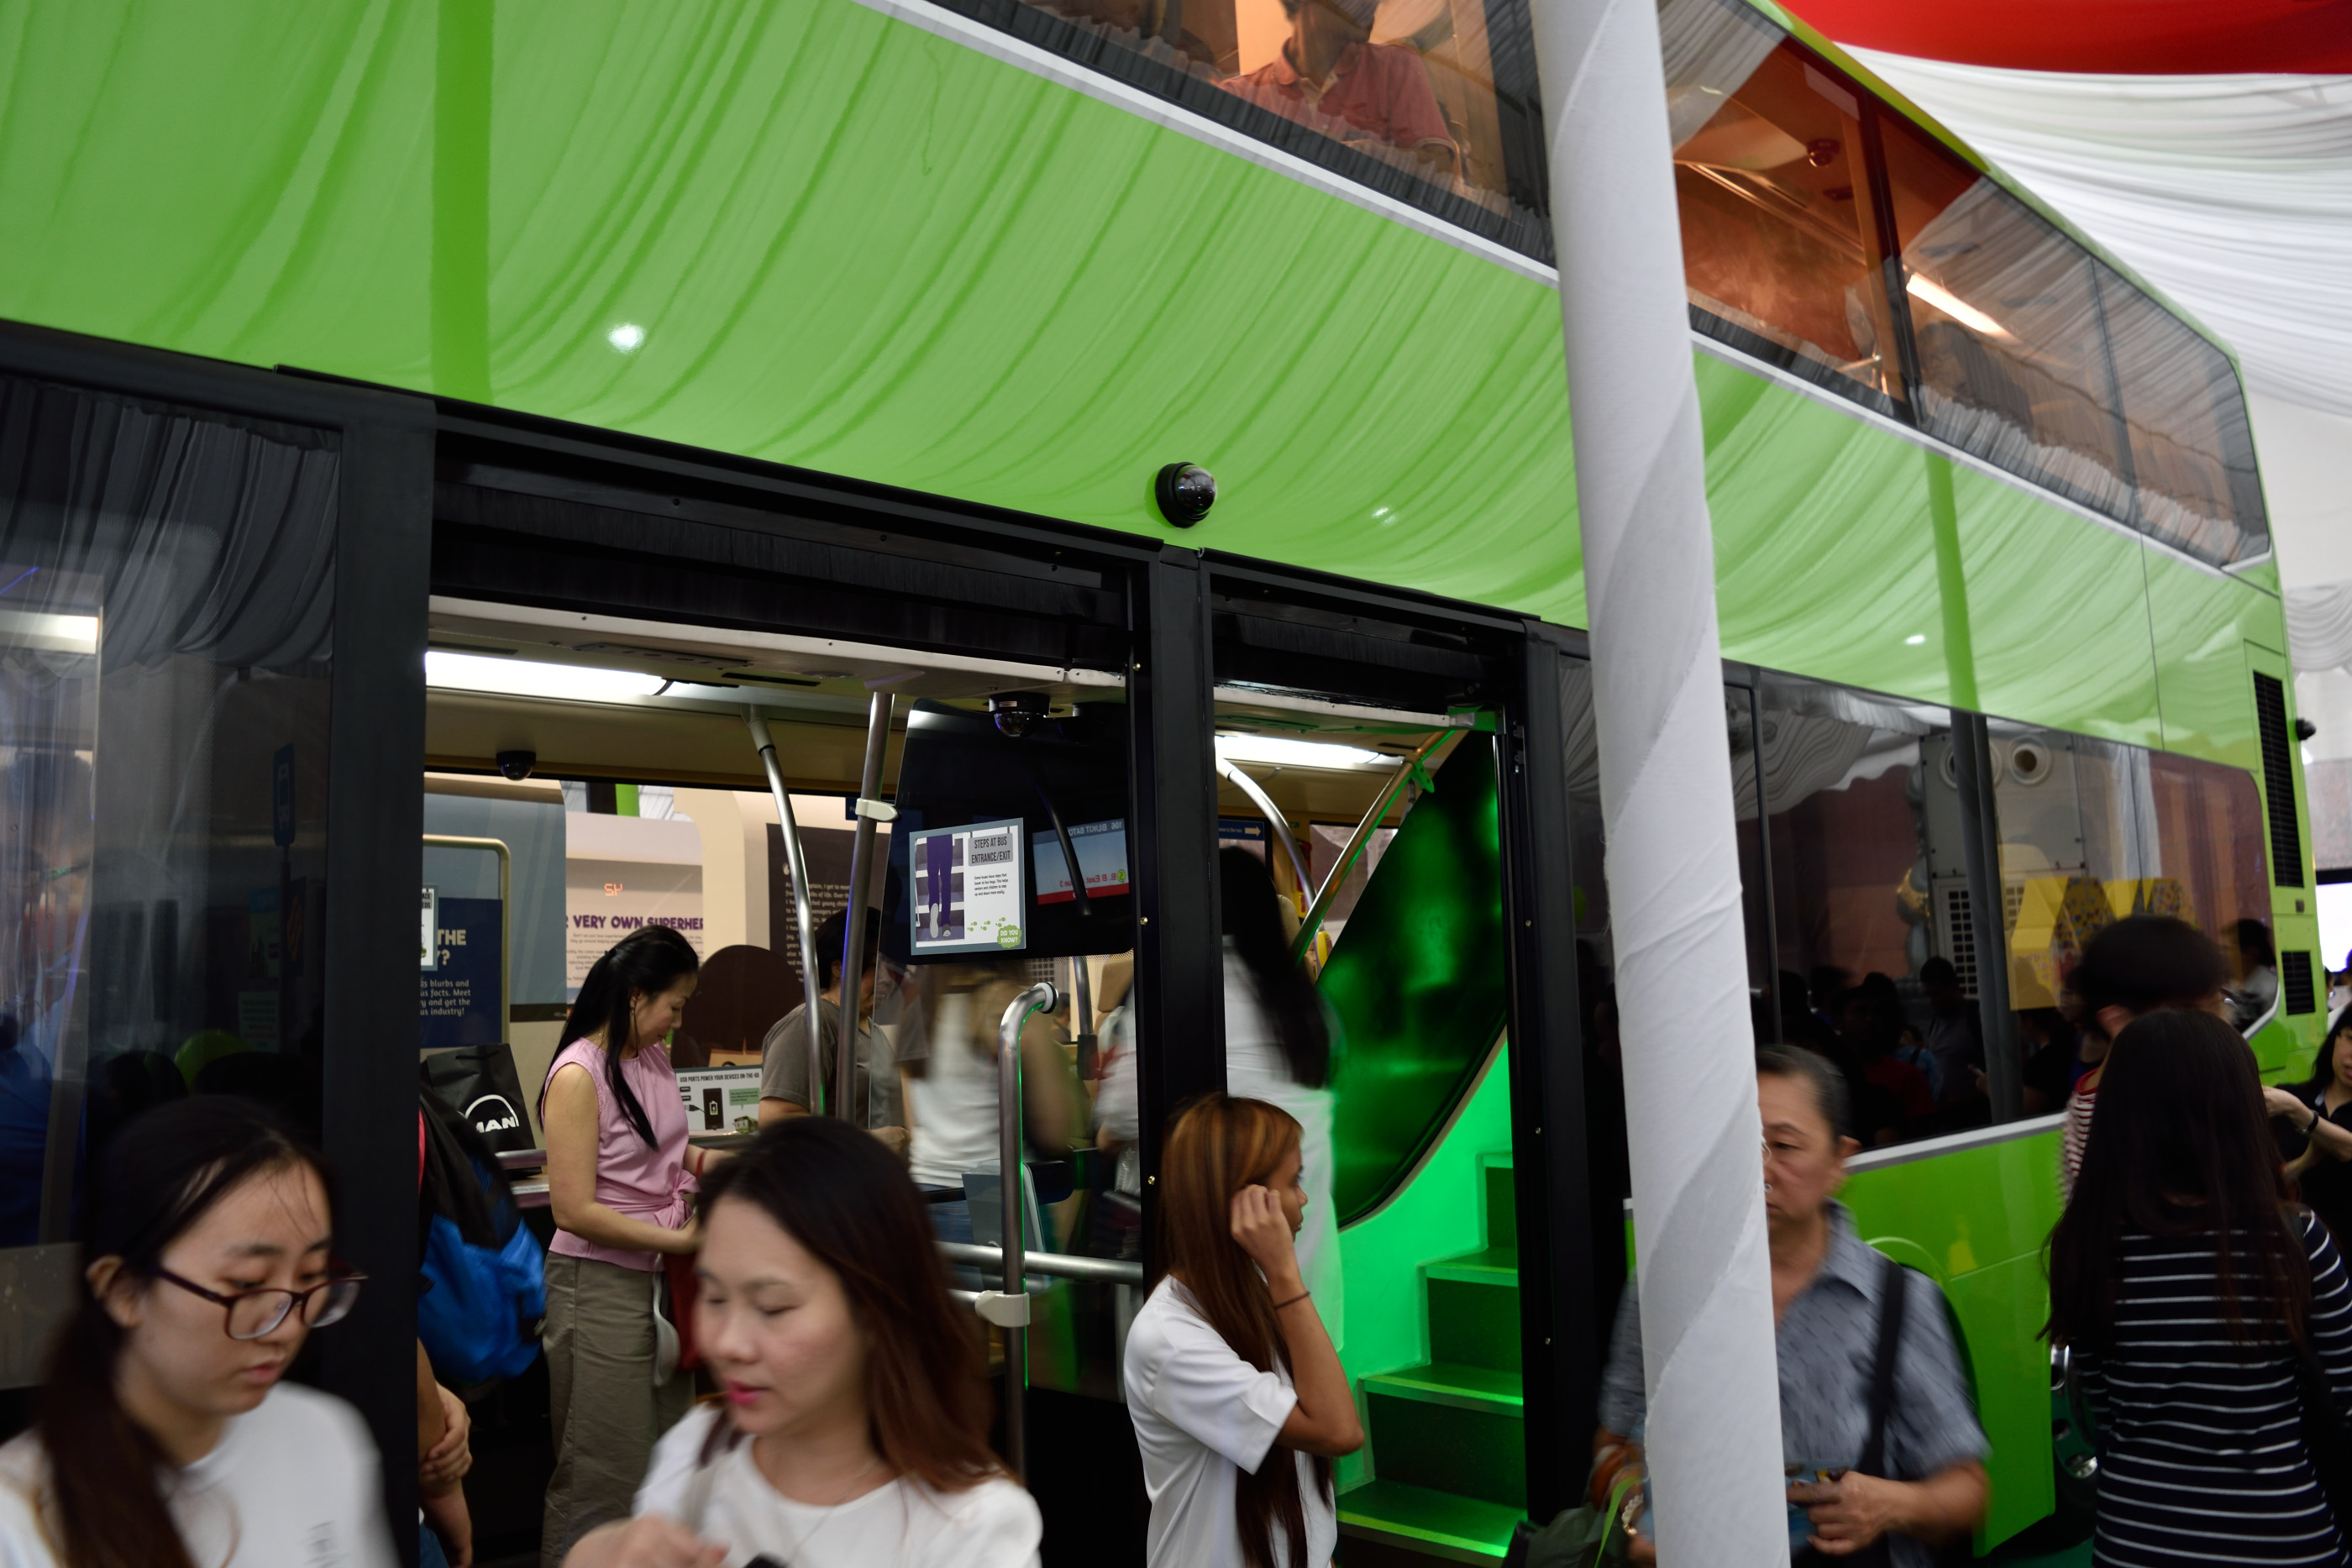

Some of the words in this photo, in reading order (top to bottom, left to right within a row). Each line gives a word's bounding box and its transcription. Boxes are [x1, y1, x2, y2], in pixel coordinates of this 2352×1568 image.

[974, 838, 989, 848] STEPS
[990, 837, 996, 847] AT
[998, 836, 1007, 846] BUS
[971, 850, 1011, 863] ENTRANCE/EXIT
[573, 915, 606, 929] VERY
[611, 915, 643, 929] OWN
[438, 929, 466, 945] THE
[430, 978, 453, 987] blurbs
[455, 978, 469, 987] and
[430, 989, 450, 998] facts.
[444, 999, 455, 1008] get
[459, 997, 470, 1005] the
[430, 1007, 464, 1016] industry!
